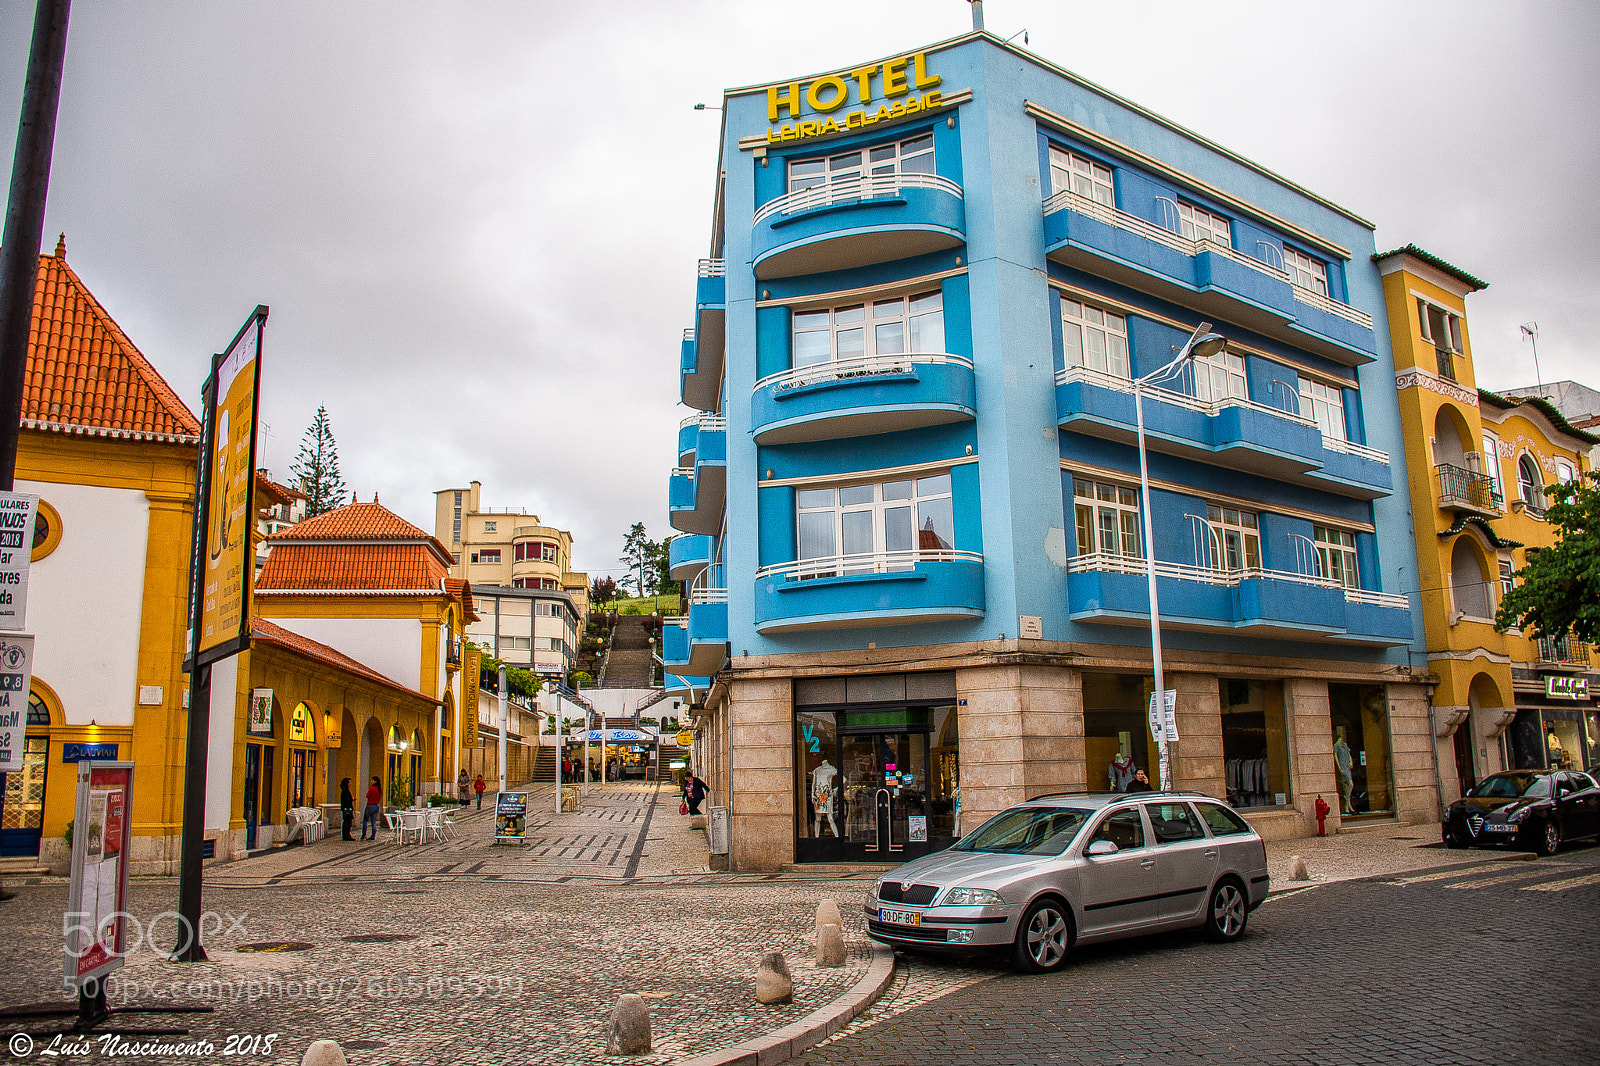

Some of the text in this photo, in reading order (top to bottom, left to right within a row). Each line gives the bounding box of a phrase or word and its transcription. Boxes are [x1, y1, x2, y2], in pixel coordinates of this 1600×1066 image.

[768, 53, 942, 123] HOTEL
[767, 90, 942, 143] LEIRIA CLASSIC
[0, 500, 30, 510] ULARES
[1, 533, 21, 546] 2018
[469, 655, 478, 684] TEATRO
[466, 685, 476, 744] MIGUEL FRANCO
